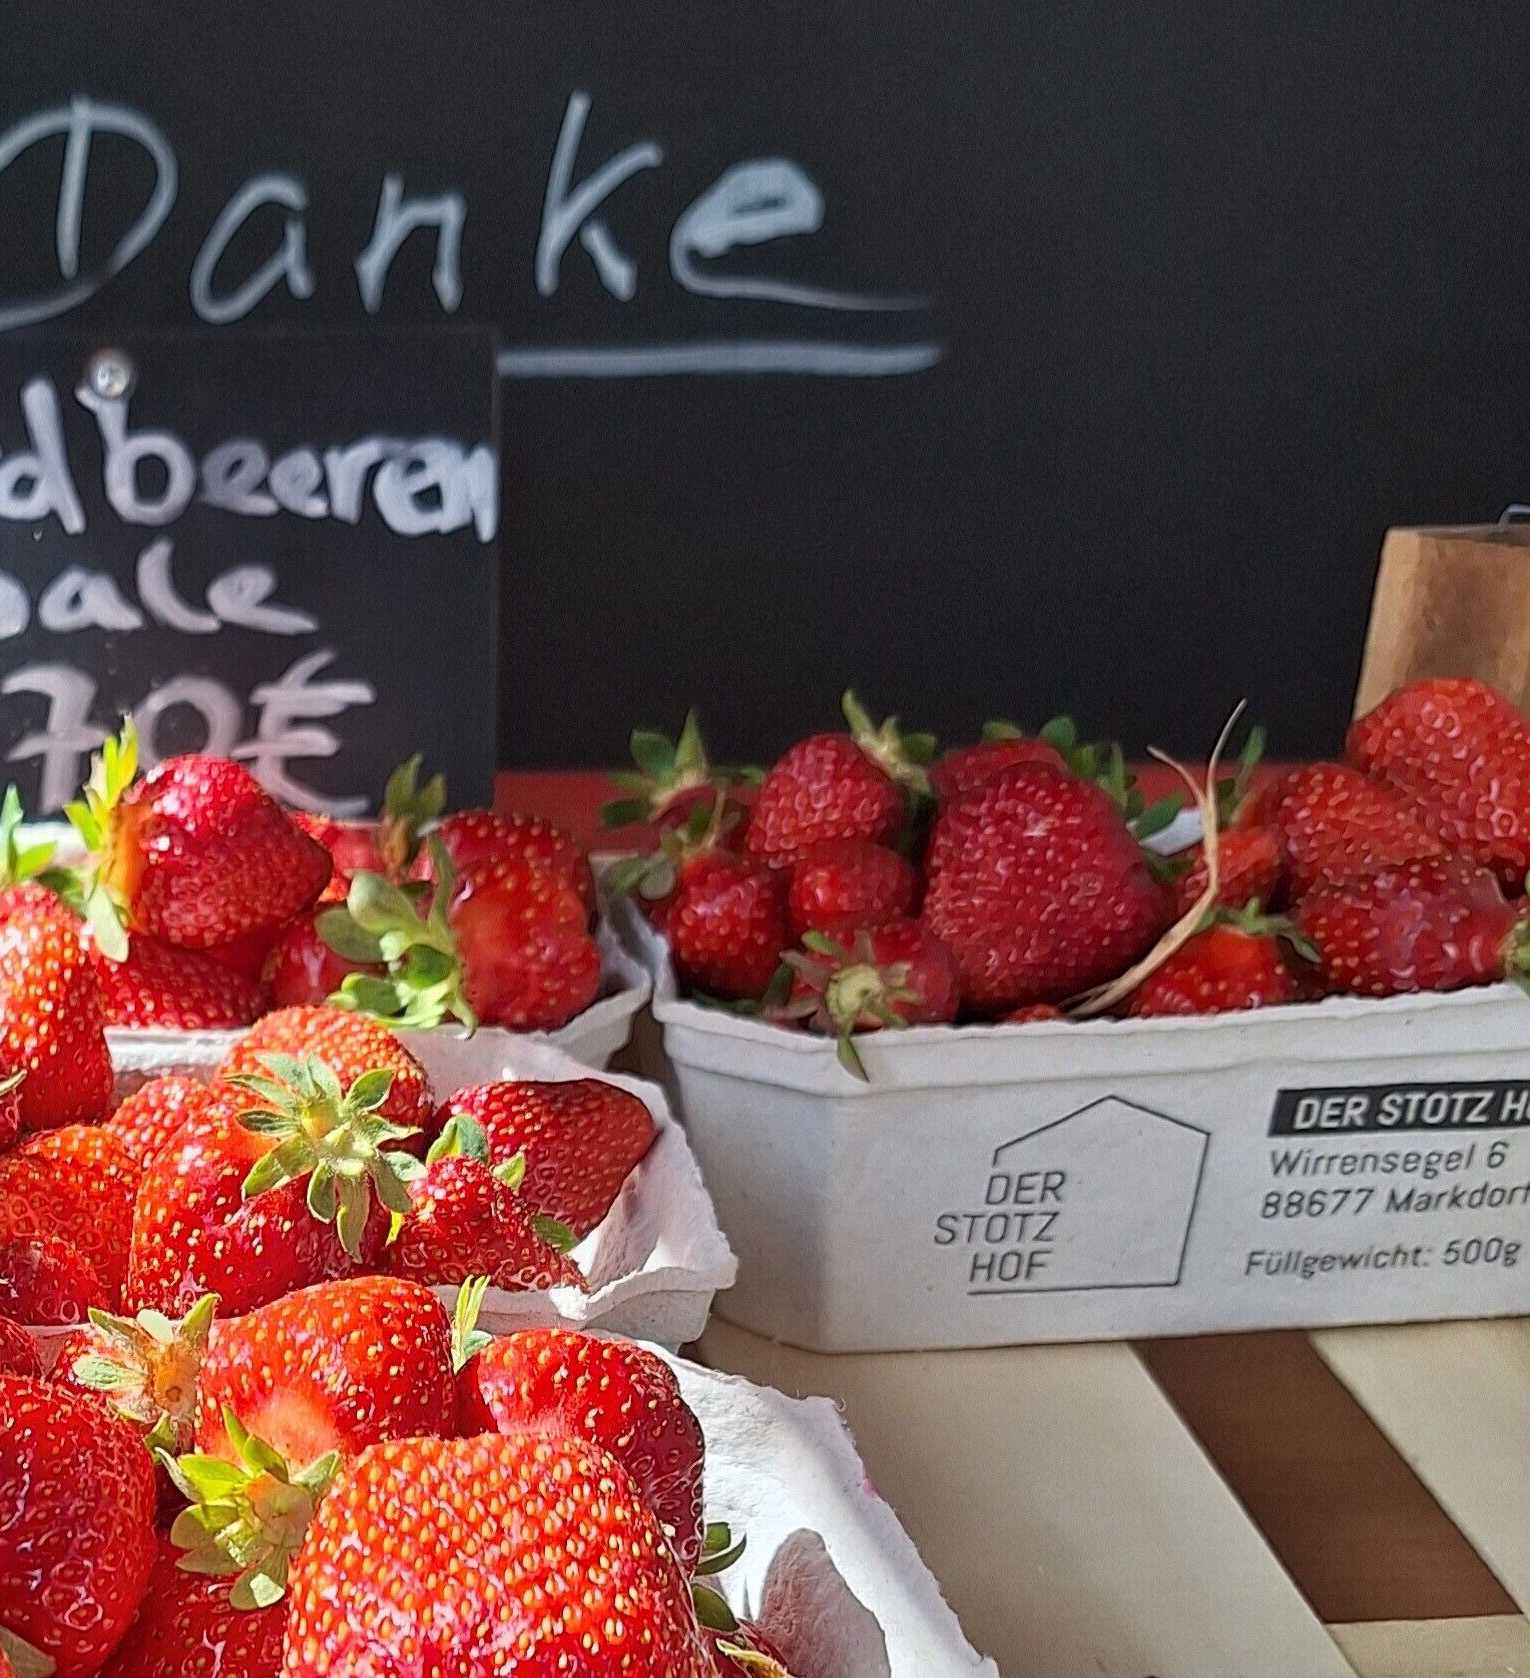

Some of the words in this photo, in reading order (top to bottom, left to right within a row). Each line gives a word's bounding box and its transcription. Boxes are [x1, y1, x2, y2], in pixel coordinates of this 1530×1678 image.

[1293, 1095, 1368, 1130] DER
[1375, 1090, 1493, 1126] STOTZ
[1270, 1144, 1476, 1180] Wirrensegel
[1486, 1141, 1511, 1169] 6
[986, 1171, 1065, 1206] DER
[1260, 1188, 1375, 1219] 88677
[934, 1212, 1060, 1246] STOTZ
[969, 1251, 1052, 1283] HOF
[1244, 1244, 1429, 1280] Füllgewicht:
[1443, 1237, 1523, 1268] 500g
